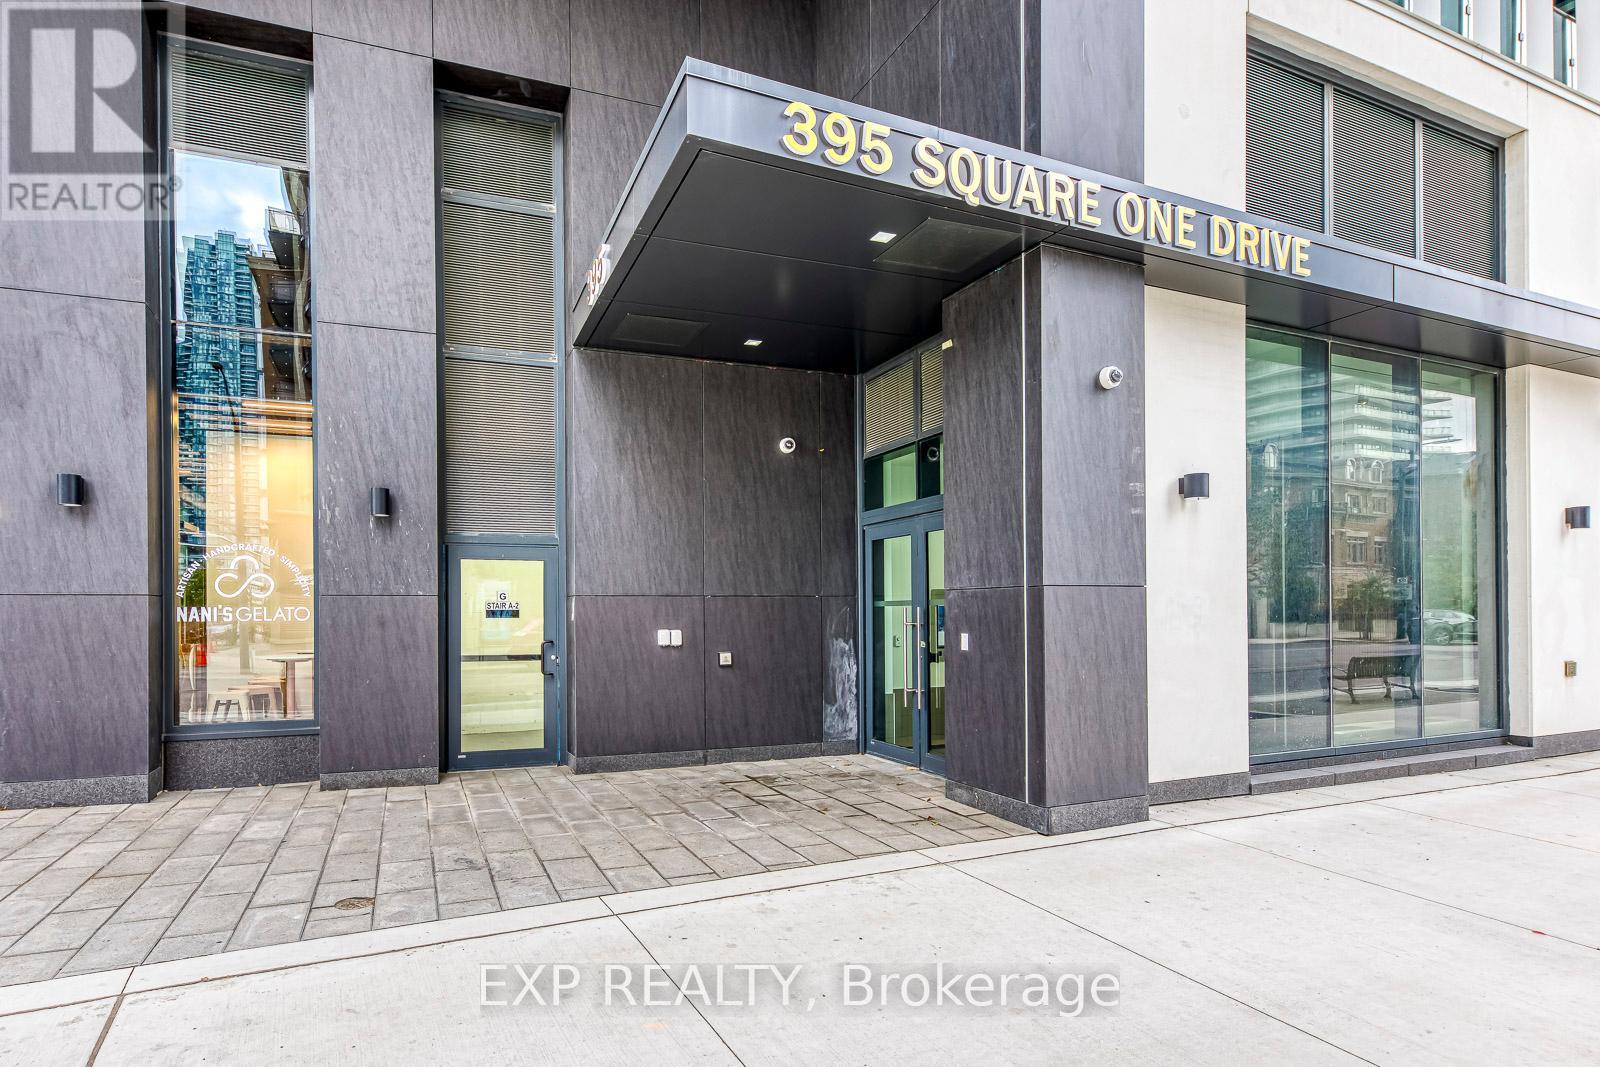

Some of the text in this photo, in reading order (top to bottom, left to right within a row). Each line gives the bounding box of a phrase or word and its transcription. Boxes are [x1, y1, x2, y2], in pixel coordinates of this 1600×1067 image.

[780, 101, 1311, 277] 395 SQUARE ONE DRIVE
[175, 560, 201, 598] ARTISAN
[203, 543, 276, 562] HANDCRAFTED
[499, 592, 507, 601] G
[176, 604, 311, 622] NANI'S GELATO
[486, 602, 519, 610] STAIR A-2
